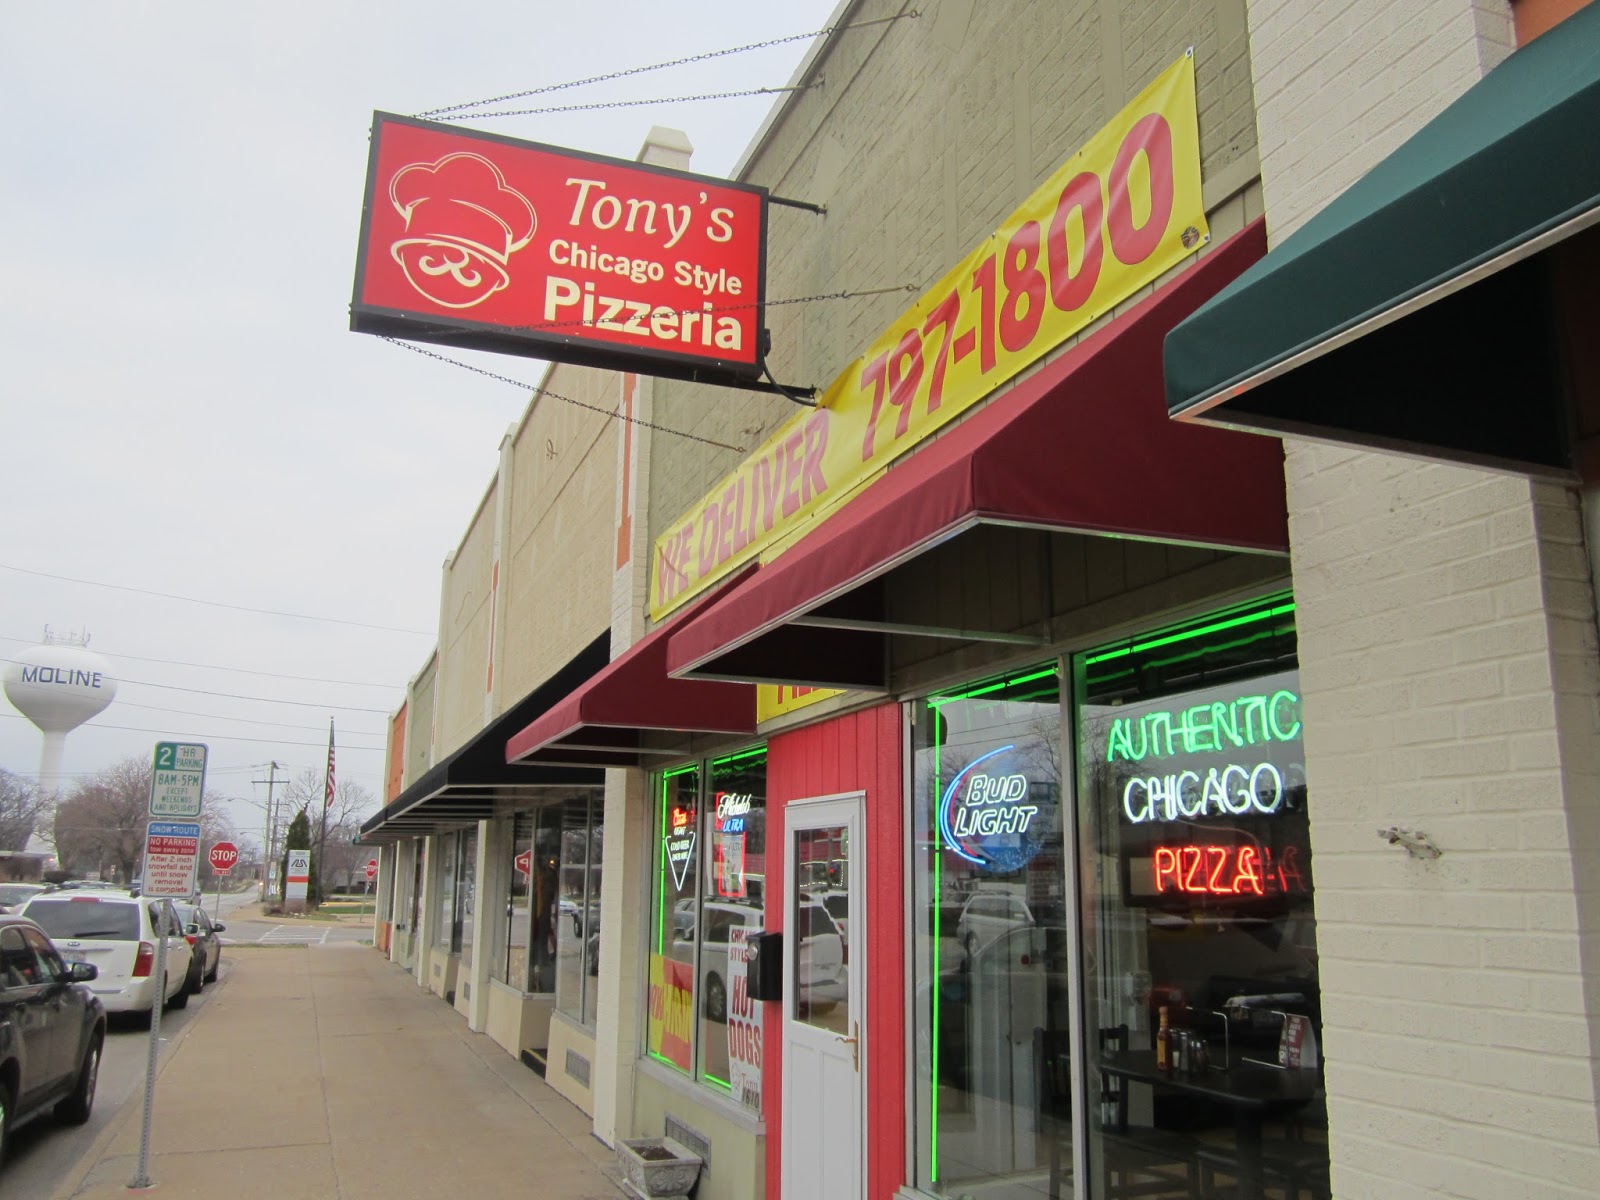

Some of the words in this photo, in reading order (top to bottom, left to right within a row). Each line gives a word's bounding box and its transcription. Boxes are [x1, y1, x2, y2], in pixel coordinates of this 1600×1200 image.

[565, 177, 735, 249] Tony's
[548, 238, 665, 284] Chicago
[673, 260, 742, 296] Style
[543, 275, 743, 351] Pizzeria
[658, 521, 695, 608] WE
[698, 408, 830, 581] DELIVER
[860, 111, 1175, 464] 797-1800
[21, 666, 102, 689] MOLINE
[1106, 689, 1302, 763] AUTHENTIC
[159, 746, 172, 766] 2
[182, 747, 196, 758] HR
[176, 758, 203, 769] PARKING
[158, 773, 200, 787] 8AM-5PM
[166, 786, 188, 795] EXCEPT
[965, 773, 1028, 806] BUD
[1122, 761, 1284, 824] CHICAGO
[161, 795, 192, 804] WEEKENDS
[154, 803, 167, 811] AND
[169, 804, 198, 813] HOLIDAYS
[722, 818, 745, 833] ULTRA
[953, 806, 1038, 838] LIGHT
[150, 825, 172, 833] SNOW
[172, 826, 198, 835] ROUTE
[150, 837, 161, 846] NO
[163, 838, 196, 847] PARKING
[150, 855, 168, 863] After
[169, 855, 175, 863] 2
[211, 849, 237, 862] STOP
[148, 862, 178, 870] snowfall
[1154, 845, 1264, 895] PIZZA
[151, 870, 168, 878] until
[154, 878, 184, 886] removal
[155, 886, 188, 894] complete
[728, 1017, 762, 1070] DOGS
